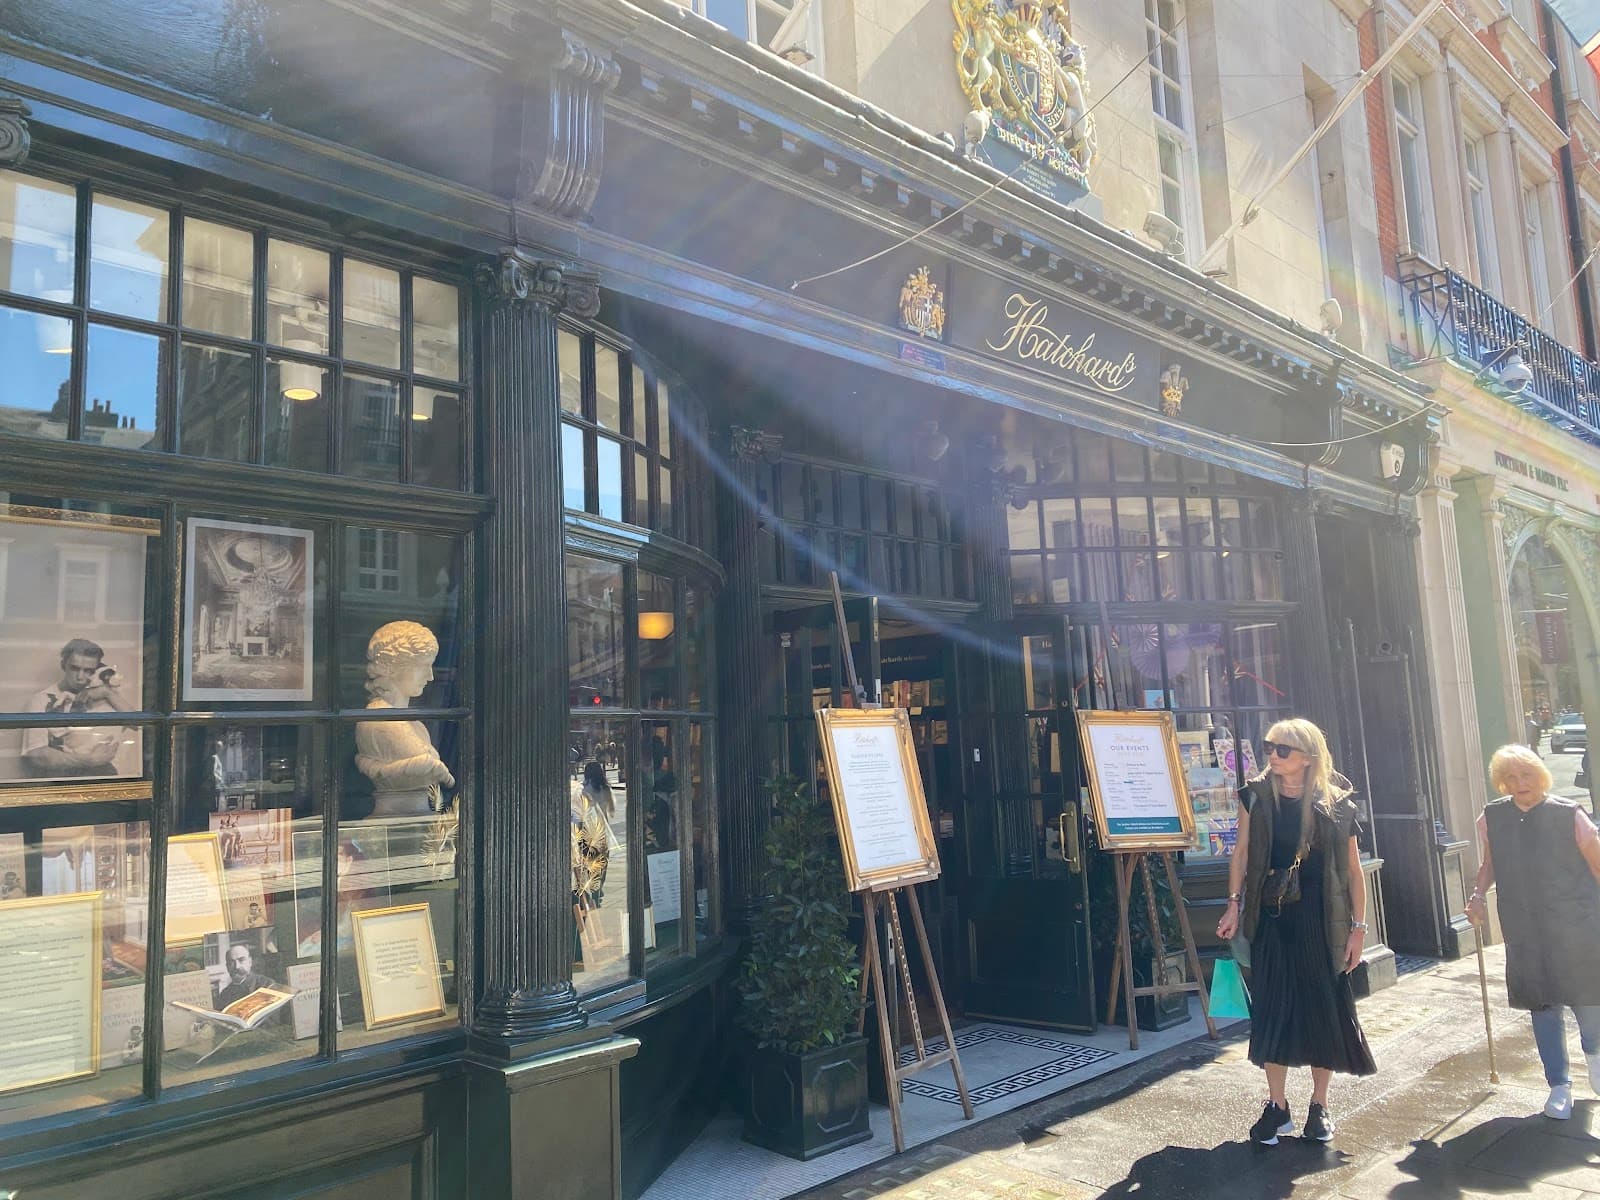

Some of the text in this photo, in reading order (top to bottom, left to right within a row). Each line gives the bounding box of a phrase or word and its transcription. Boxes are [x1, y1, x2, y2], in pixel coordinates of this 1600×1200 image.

[985, 293, 1137, 392] Hatchards
[1110, 744, 1151, 752] OUR EVENTS
